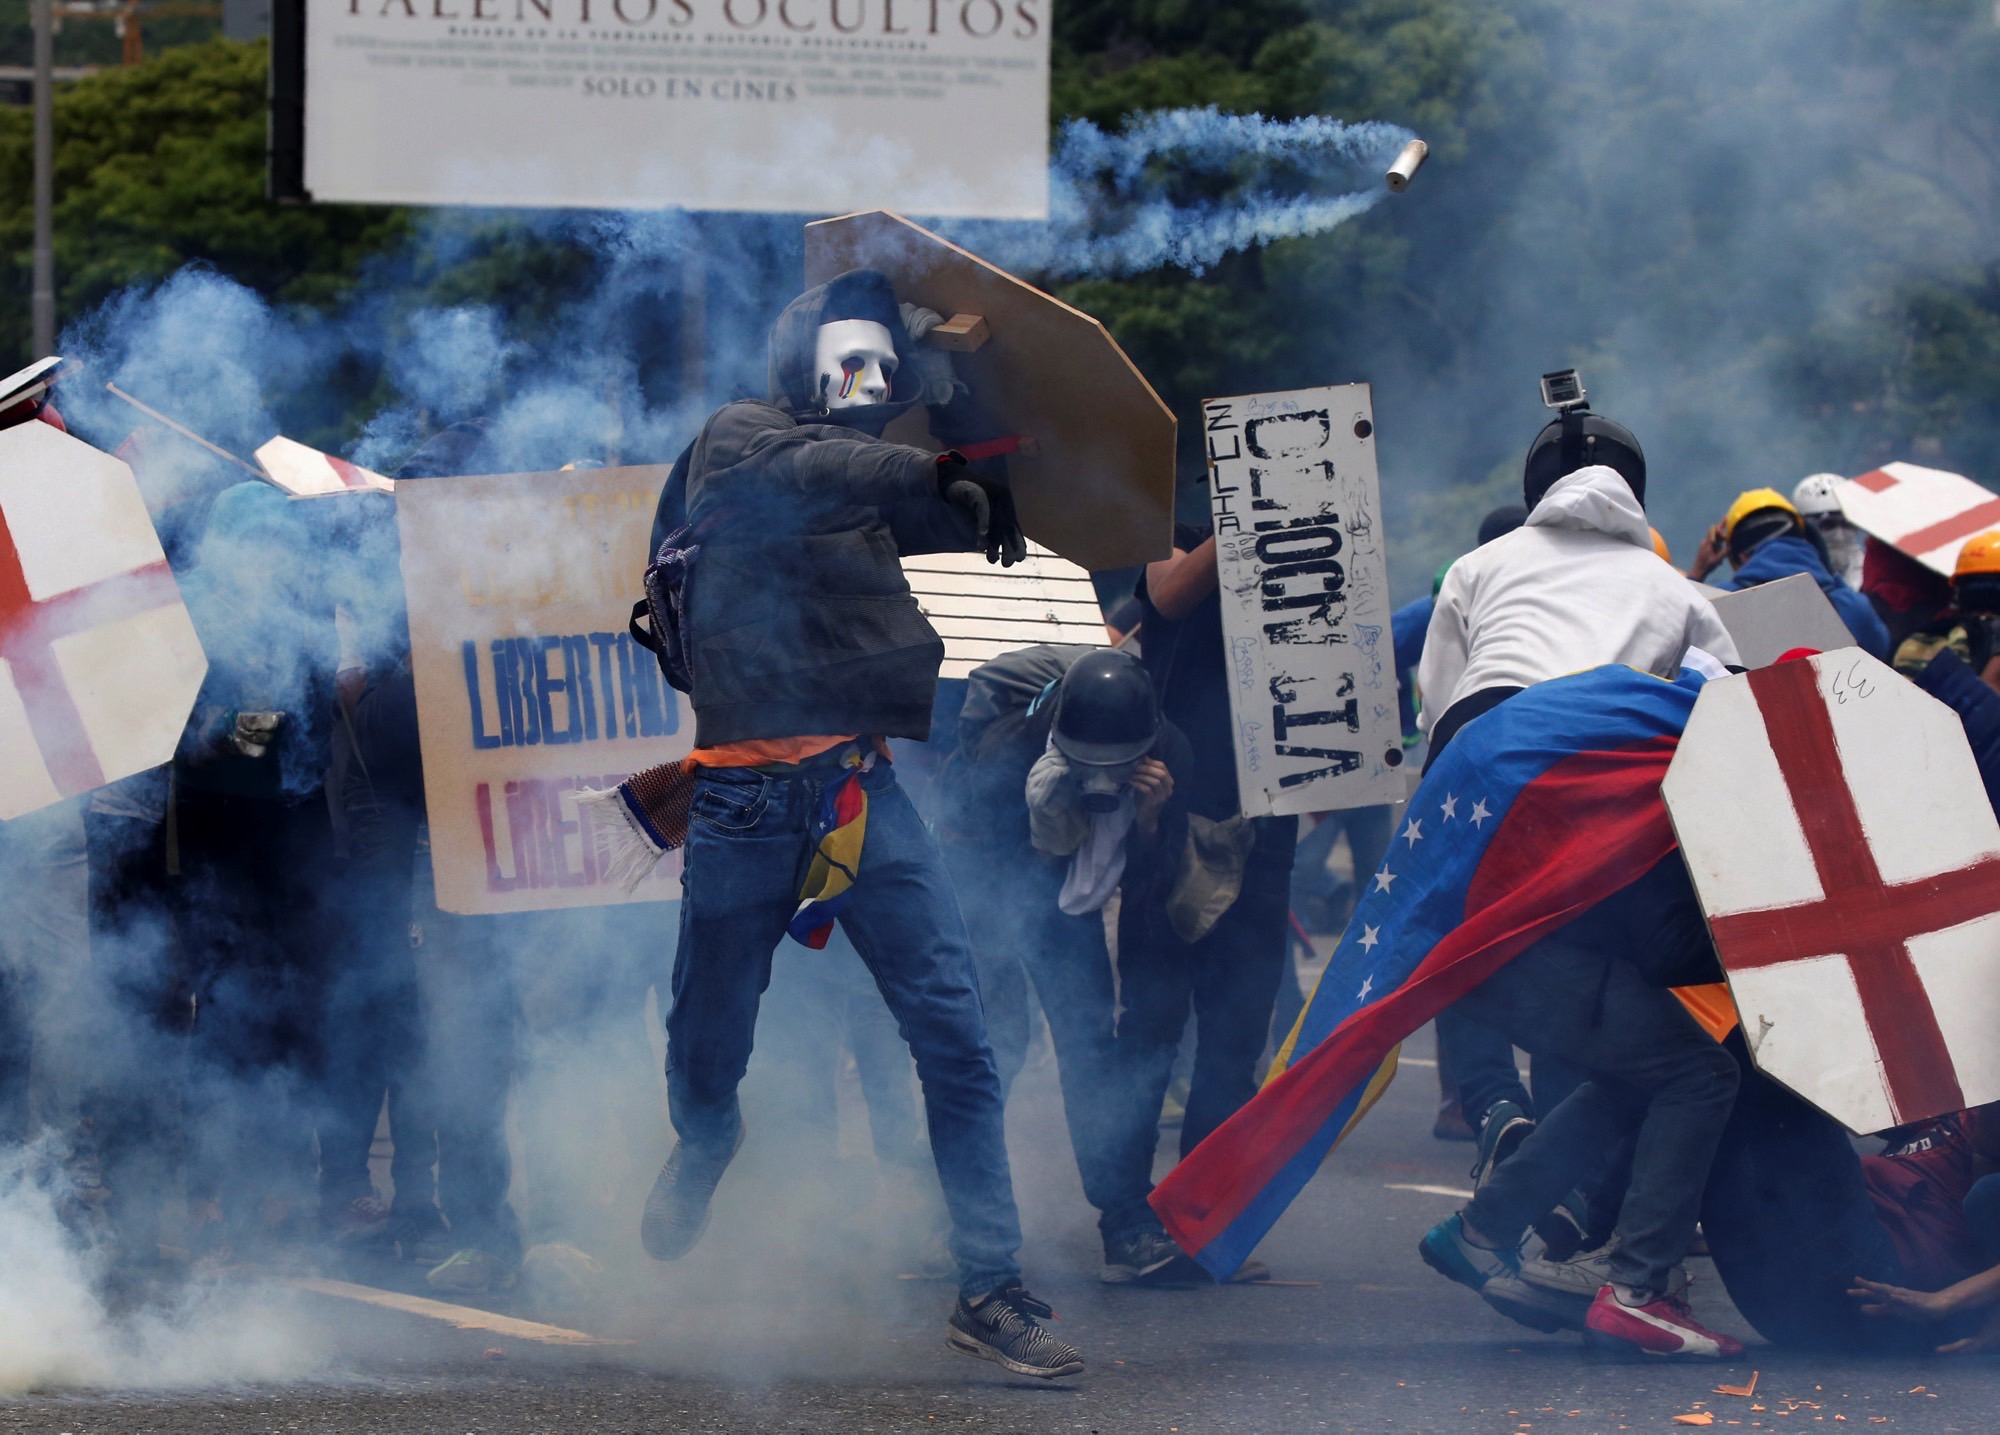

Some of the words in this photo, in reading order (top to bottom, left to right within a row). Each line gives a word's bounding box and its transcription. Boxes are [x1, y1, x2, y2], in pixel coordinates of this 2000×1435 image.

[722, 0, 1039, 40] OCULTOS
[583, 75, 657, 98] SOLO
[665, 77, 703, 99] EN
[711, 78, 798, 102] CINES
[1206, 404, 1242, 535] ZULIA
